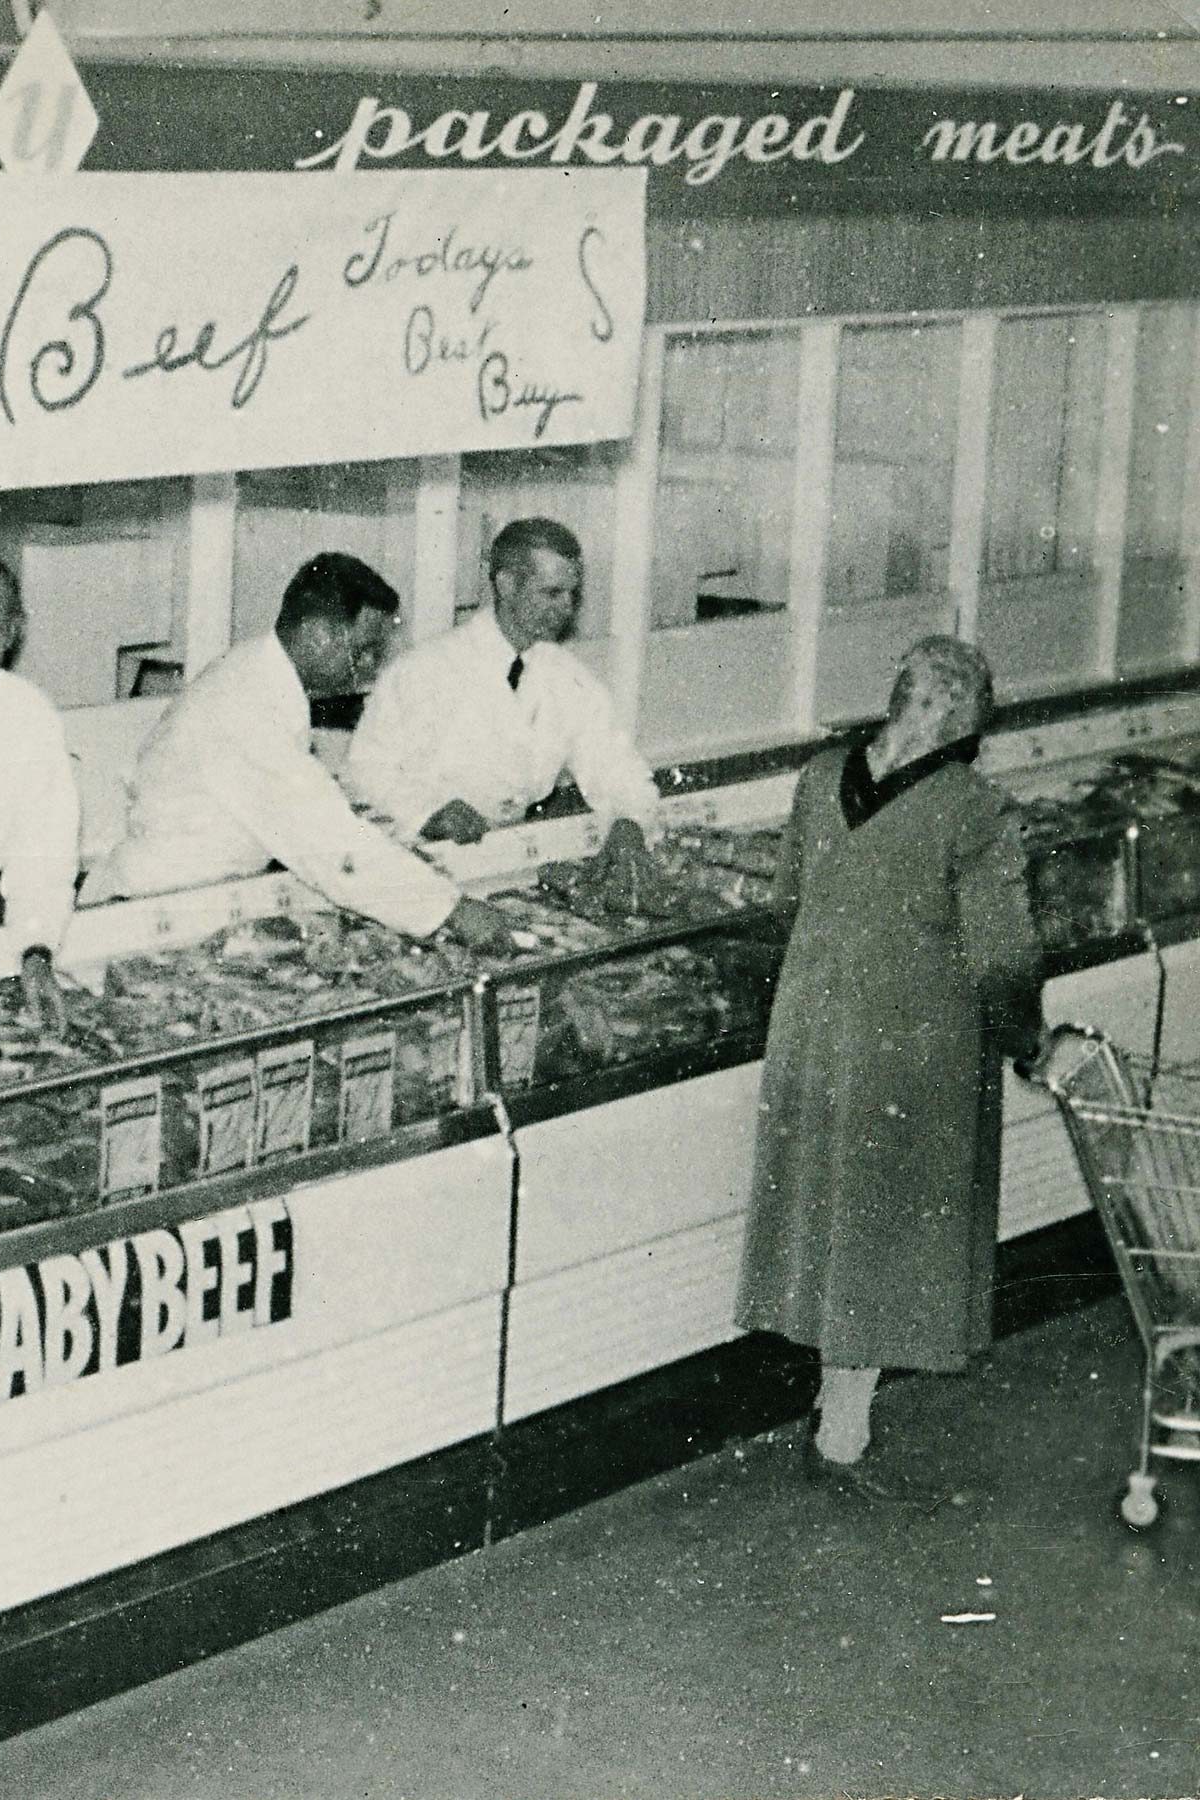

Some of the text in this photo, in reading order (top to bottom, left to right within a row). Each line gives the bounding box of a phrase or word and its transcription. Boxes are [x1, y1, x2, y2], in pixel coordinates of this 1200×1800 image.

[295, 82, 1186, 186] packaged meats
[342, 209, 535, 314] Todays
[403, 304, 497, 376] Best
[477, 351, 583, 439] Buy
[128, 1196, 293, 1360] BEEF
